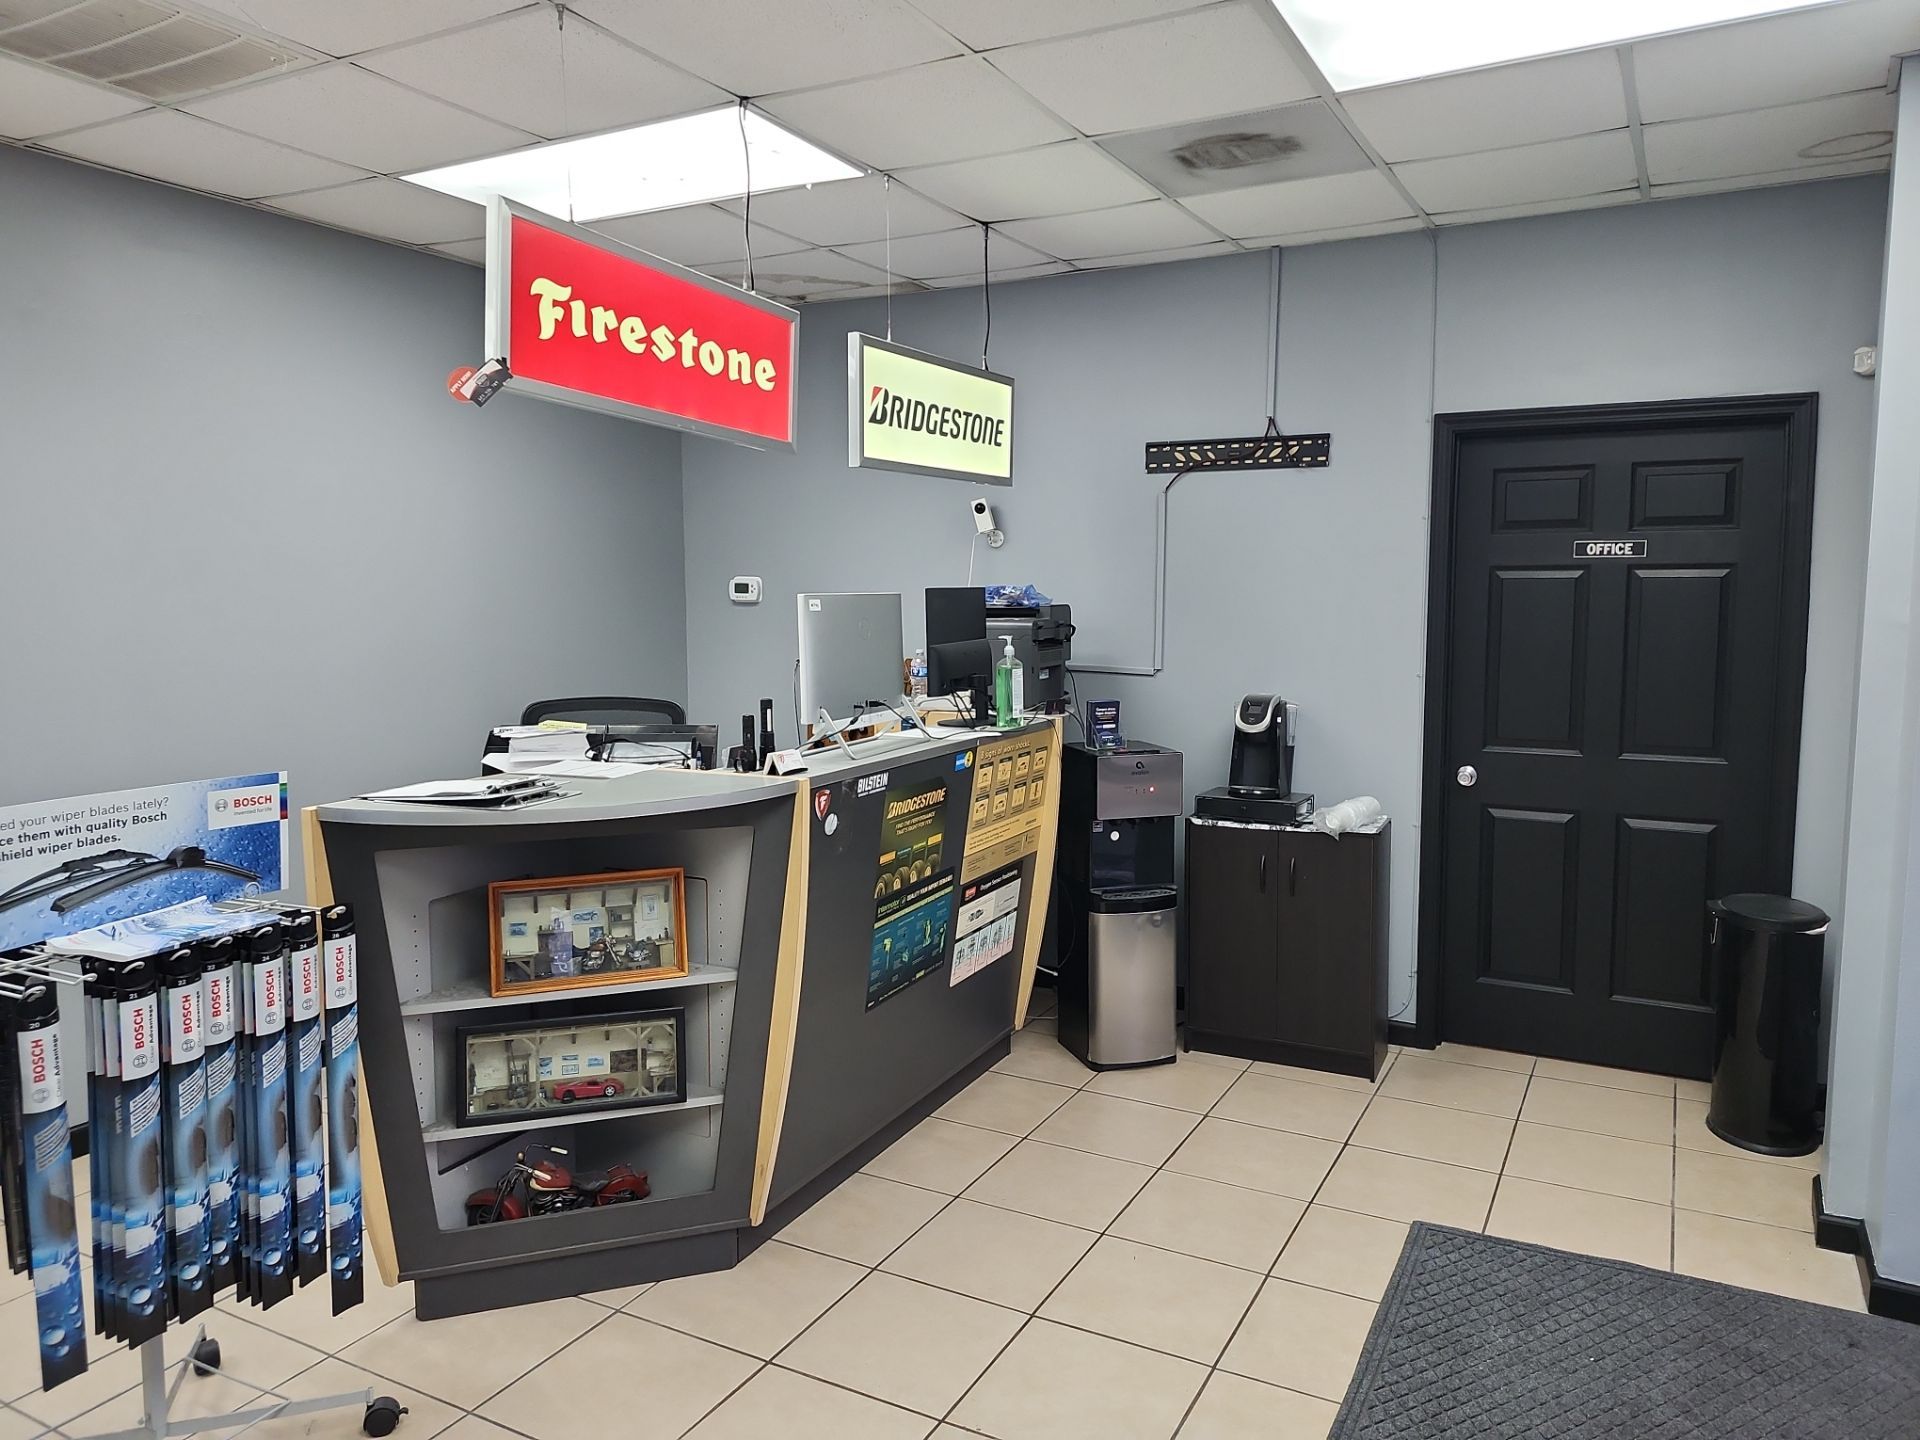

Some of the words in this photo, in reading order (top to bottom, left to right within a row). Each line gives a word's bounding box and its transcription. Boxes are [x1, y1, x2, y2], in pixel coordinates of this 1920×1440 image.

[530, 277, 776, 392] Firestone
[868, 386, 1005, 447] BRIDGESTONE
[1586, 543, 1634, 555] OFFICE
[857, 772, 889, 793] BILSTEIN
[19, 816, 48, 831] your
[51, 809, 86, 824] wiper
[89, 804, 130, 817] blades
[133, 797, 169, 811] lately?
[233, 795, 272, 808] BOSCH
[886, 787, 947, 820] BRIDGESTONE
[18, 830, 51, 843] them
[55, 825, 82, 837] with
[86, 818, 128, 834] quality
[132, 811, 168, 825] Bosch
[37, 841, 74, 855] wiper
[77, 834, 121, 848] blades.
[302, 957, 312, 995] BOSCH
[336, 946, 345, 983] BOSCH
[210, 979, 222, 1018] BOSCH
[265, 969, 276, 1008] BOSCH
[133, 1007, 145, 1050] BOSCH
[181, 994, 193, 1034] BOSCH
[30, 1038, 46, 1084] BOSCH
